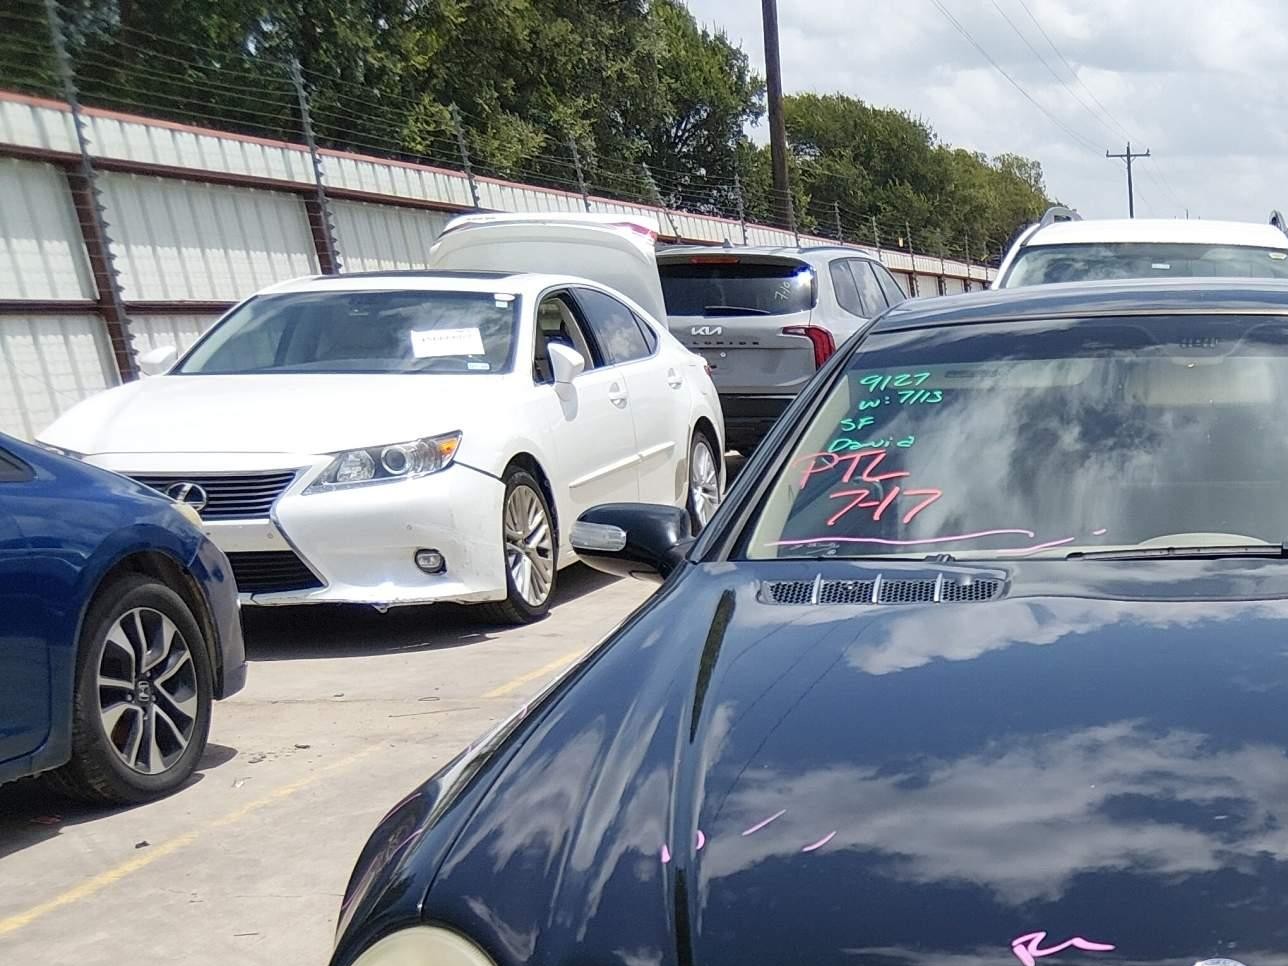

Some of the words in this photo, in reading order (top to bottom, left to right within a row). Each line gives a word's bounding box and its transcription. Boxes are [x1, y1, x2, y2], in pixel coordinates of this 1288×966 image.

[690, 326, 722, 336] KIA
[840, 416, 875, 432] SF
[827, 435, 915, 453] David
